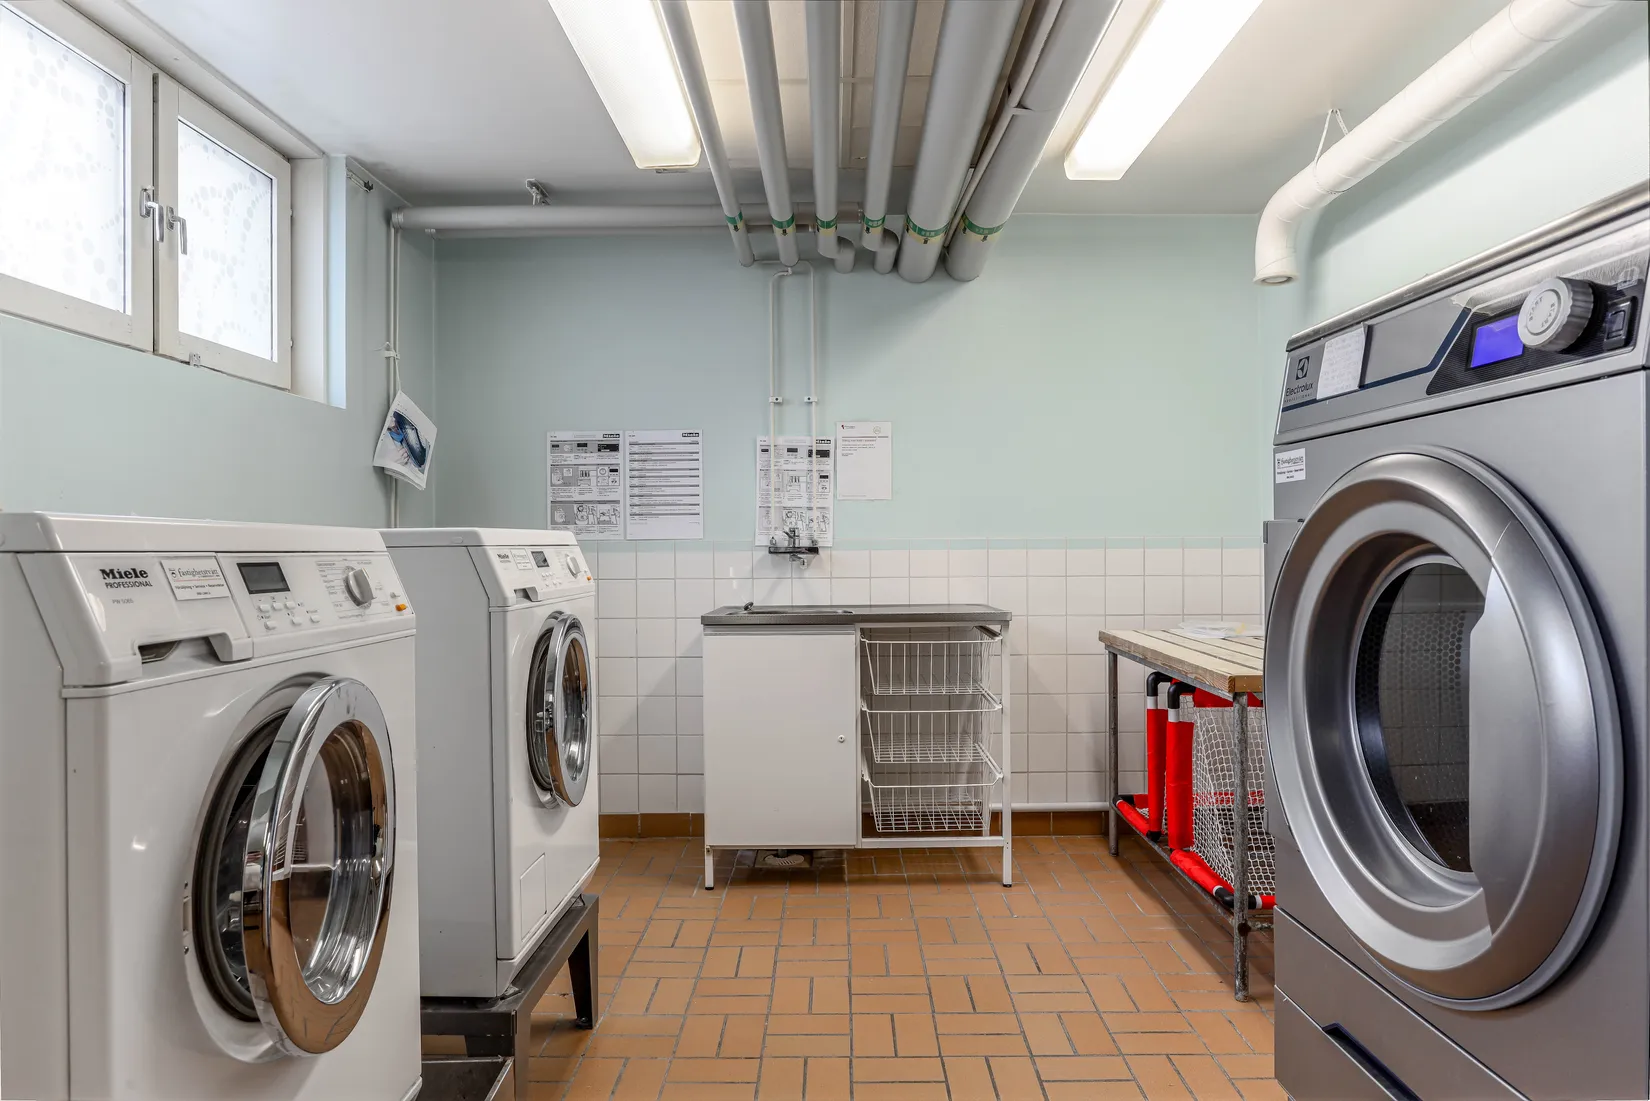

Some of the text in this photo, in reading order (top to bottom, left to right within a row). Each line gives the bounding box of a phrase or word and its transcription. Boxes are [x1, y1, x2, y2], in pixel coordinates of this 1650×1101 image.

[1286, 382, 1314, 397] Electrolux
[99, 568, 149, 579] Miele
[105, 580, 153, 589] PROFESSIONAL
